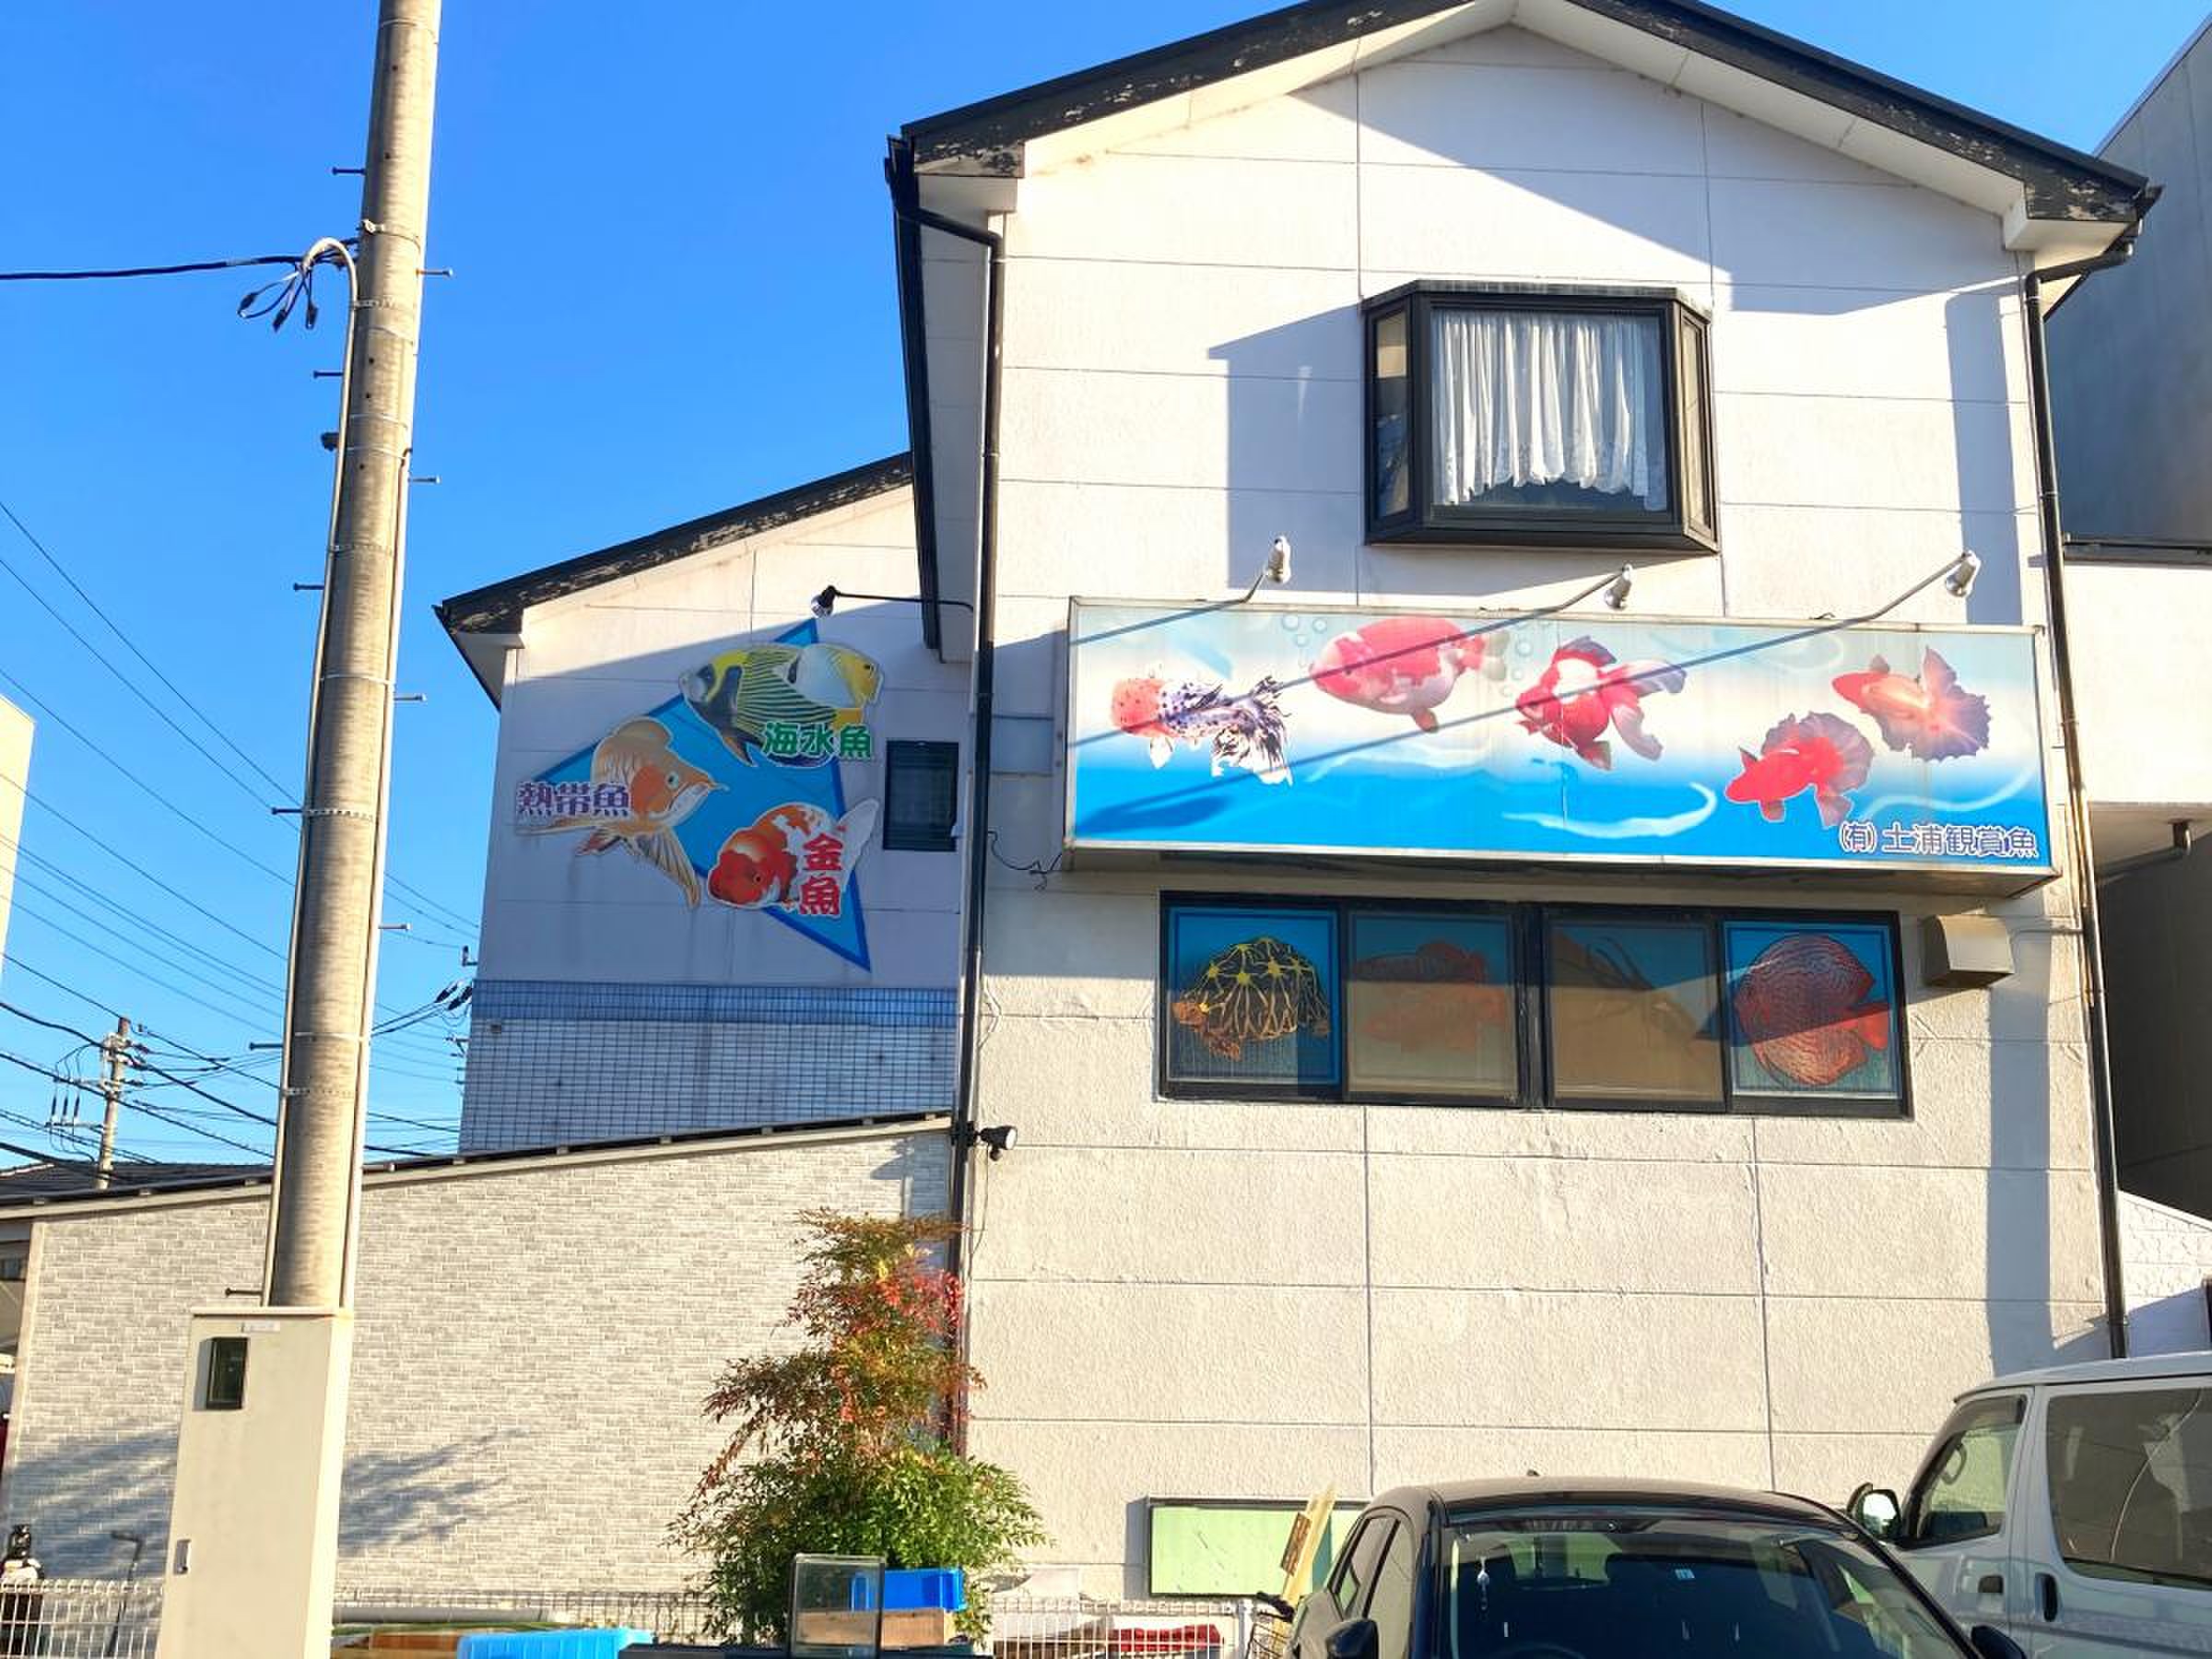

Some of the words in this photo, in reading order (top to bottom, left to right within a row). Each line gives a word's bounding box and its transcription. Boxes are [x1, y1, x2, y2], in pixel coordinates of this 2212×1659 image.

[762, 722, 872, 759] 海水魚
[516, 782, 630, 817] 熱帯魚
[799, 832, 844, 915] 金魚
